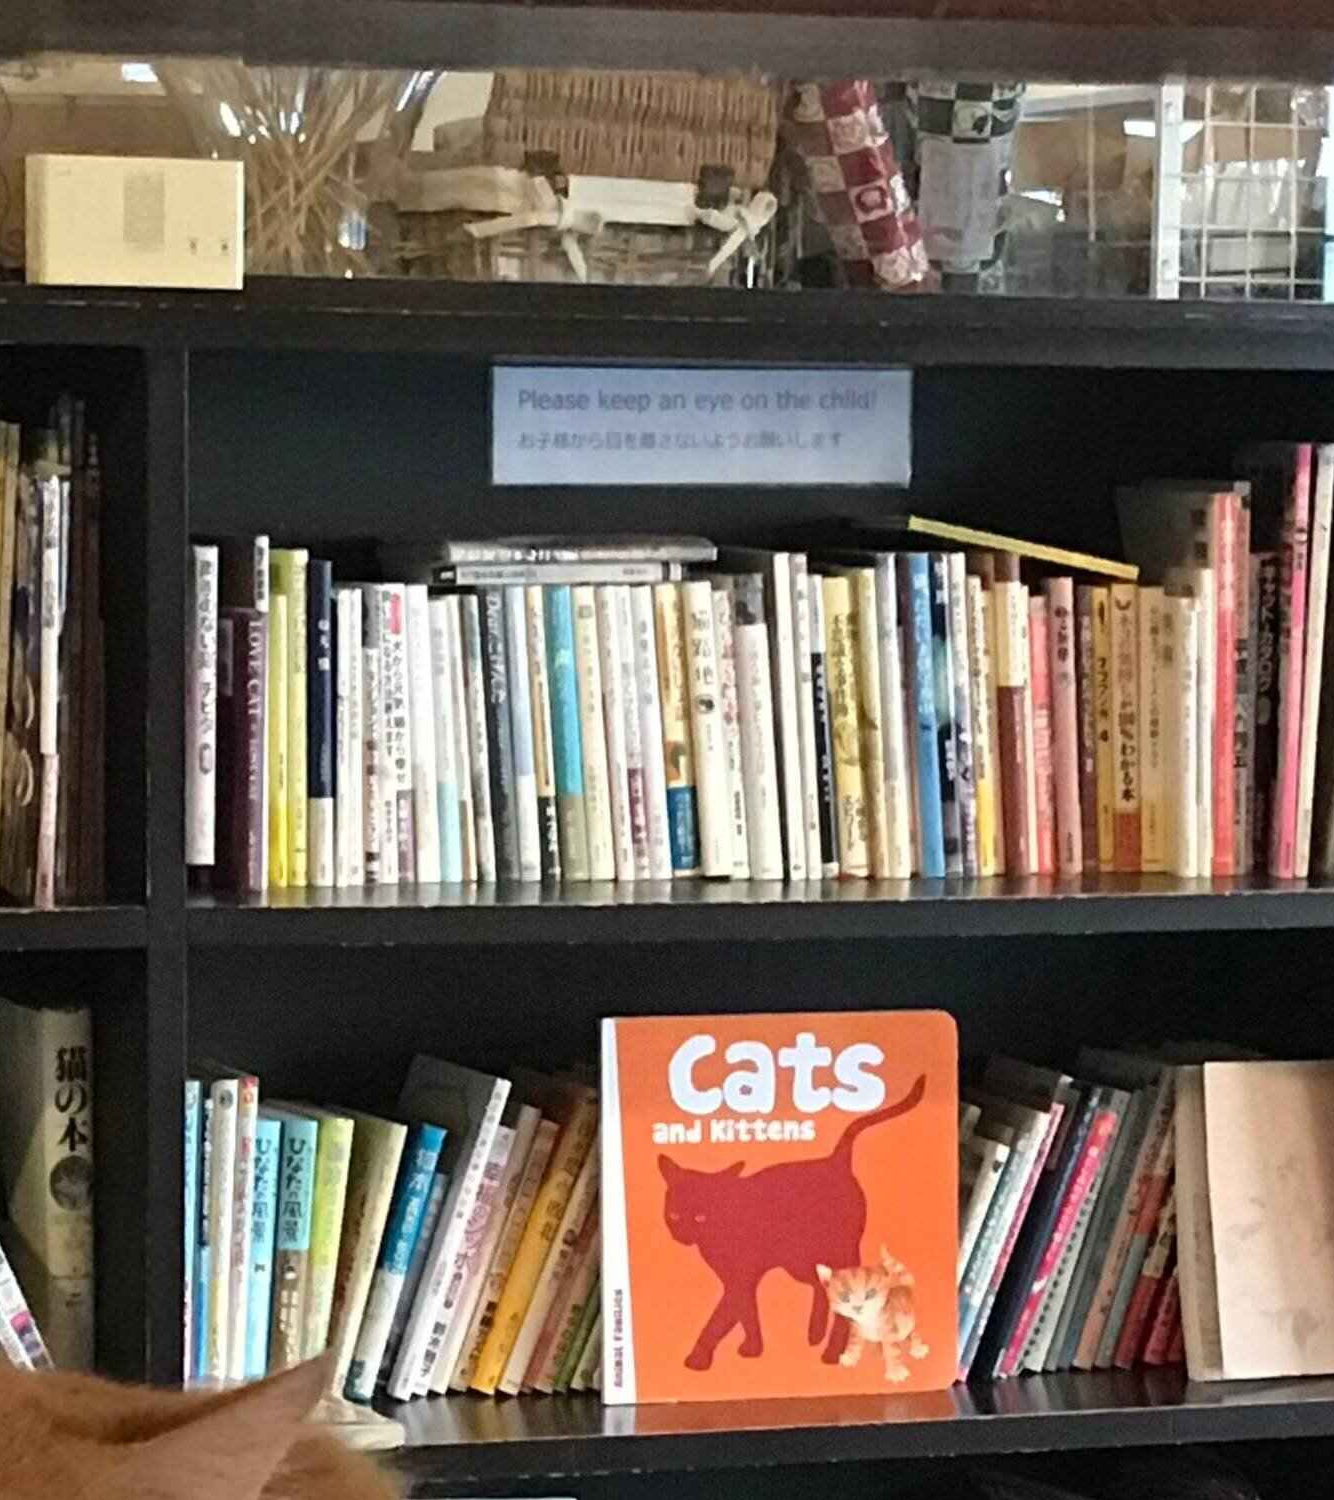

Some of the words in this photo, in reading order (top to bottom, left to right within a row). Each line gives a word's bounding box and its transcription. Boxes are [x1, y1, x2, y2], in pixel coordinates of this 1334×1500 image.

[518, 388, 590, 411] Please
[598, 389, 651, 414] keep
[658, 392, 686, 411] an
[694, 393, 734, 415] eye
[742, 393, 769, 411] on
[776, 390, 812, 411] the
[53, 1044, 89, 1152] 猫の本
[667, 1031, 886, 1115] Cats
[652, 1119, 702, 1145] and
[710, 1117, 817, 1144] Kittens
